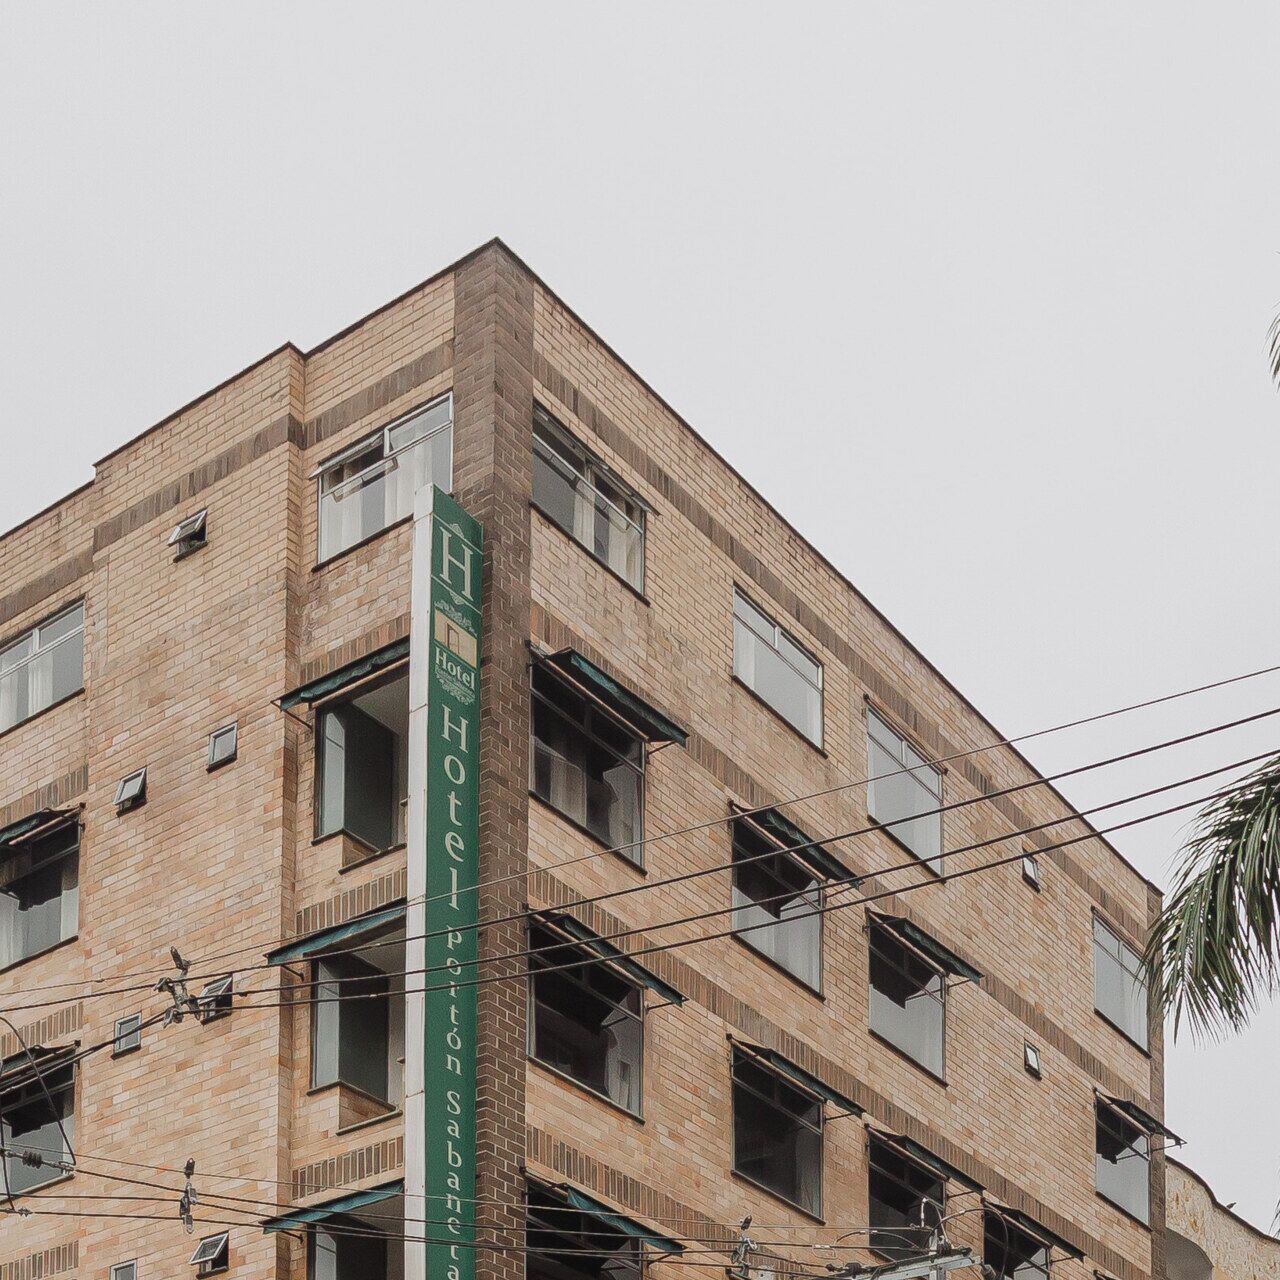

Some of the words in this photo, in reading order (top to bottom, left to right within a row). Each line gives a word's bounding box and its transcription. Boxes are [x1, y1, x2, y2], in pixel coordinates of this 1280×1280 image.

[440, 527, 473, 602] H
[435, 647, 475, 690] Hotel
[441, 705, 469, 911] Hotel
